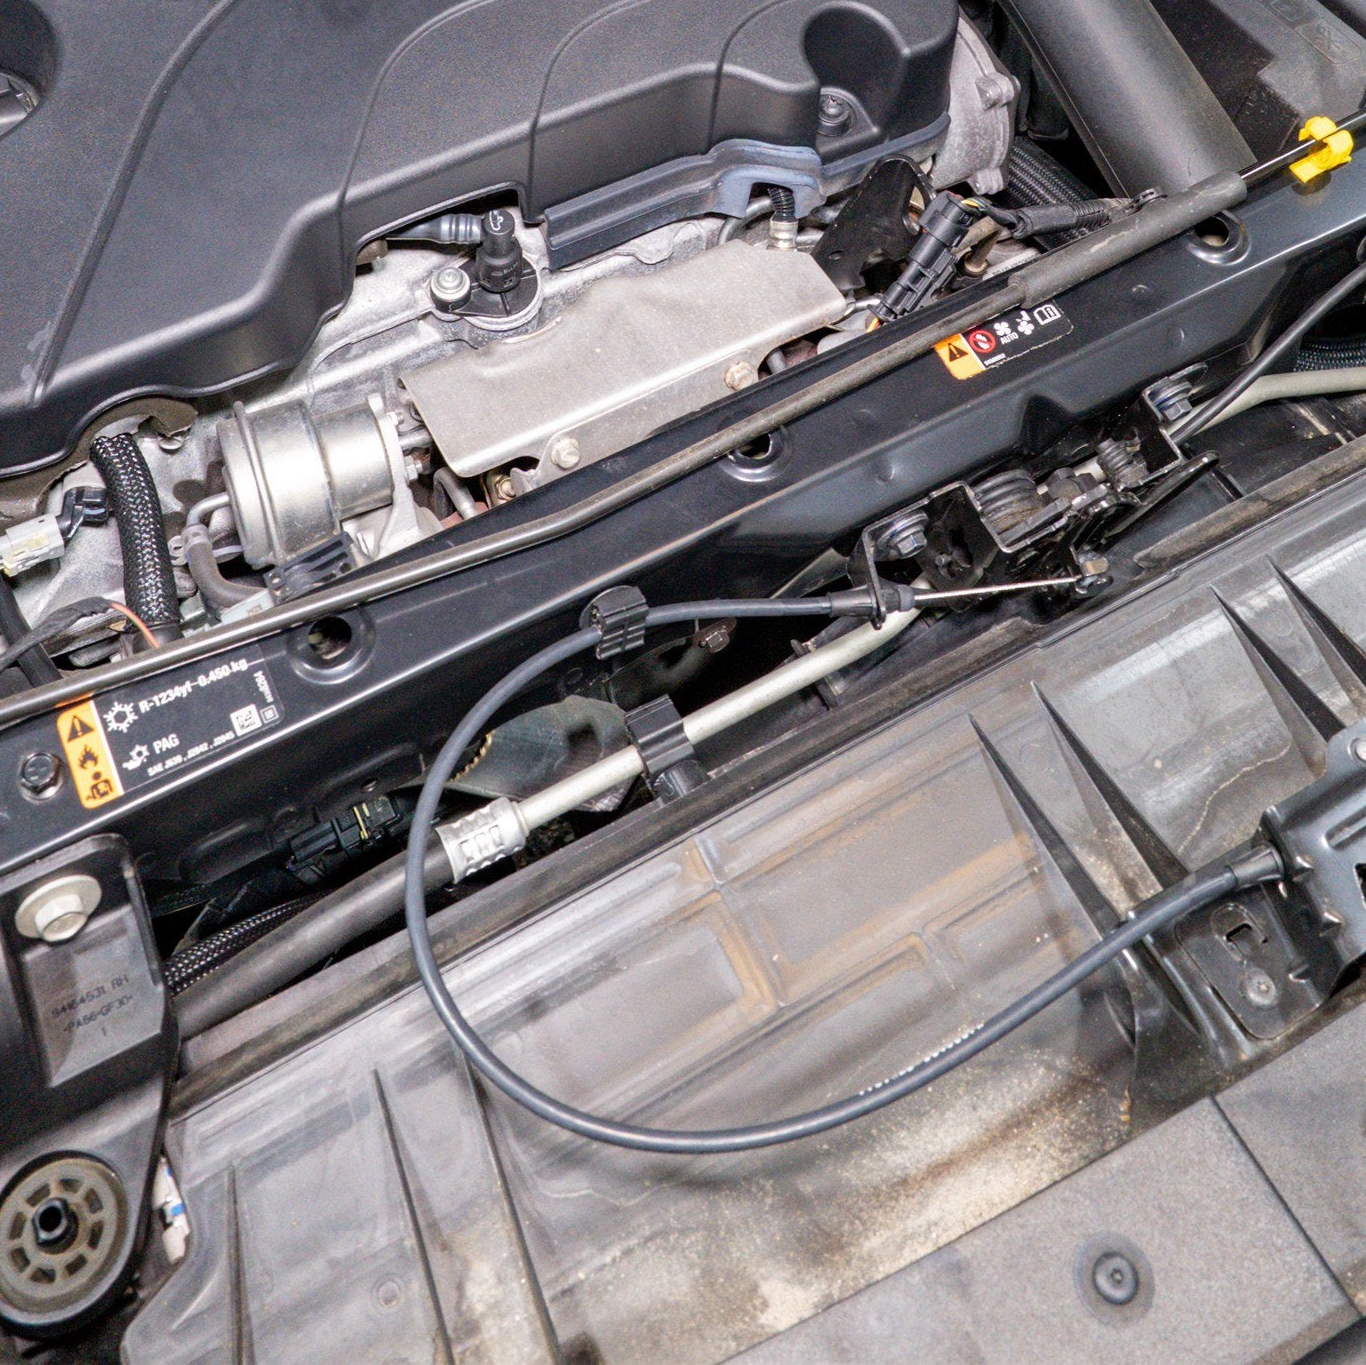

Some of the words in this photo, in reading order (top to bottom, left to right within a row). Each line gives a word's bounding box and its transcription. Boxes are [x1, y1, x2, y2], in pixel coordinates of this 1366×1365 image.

[1000, 332, 1019, 345] AUTO
[138, 680, 193, 714] R-1234yf
[233, 658, 249, 674] kg
[152, 733, 180, 754] PAG
